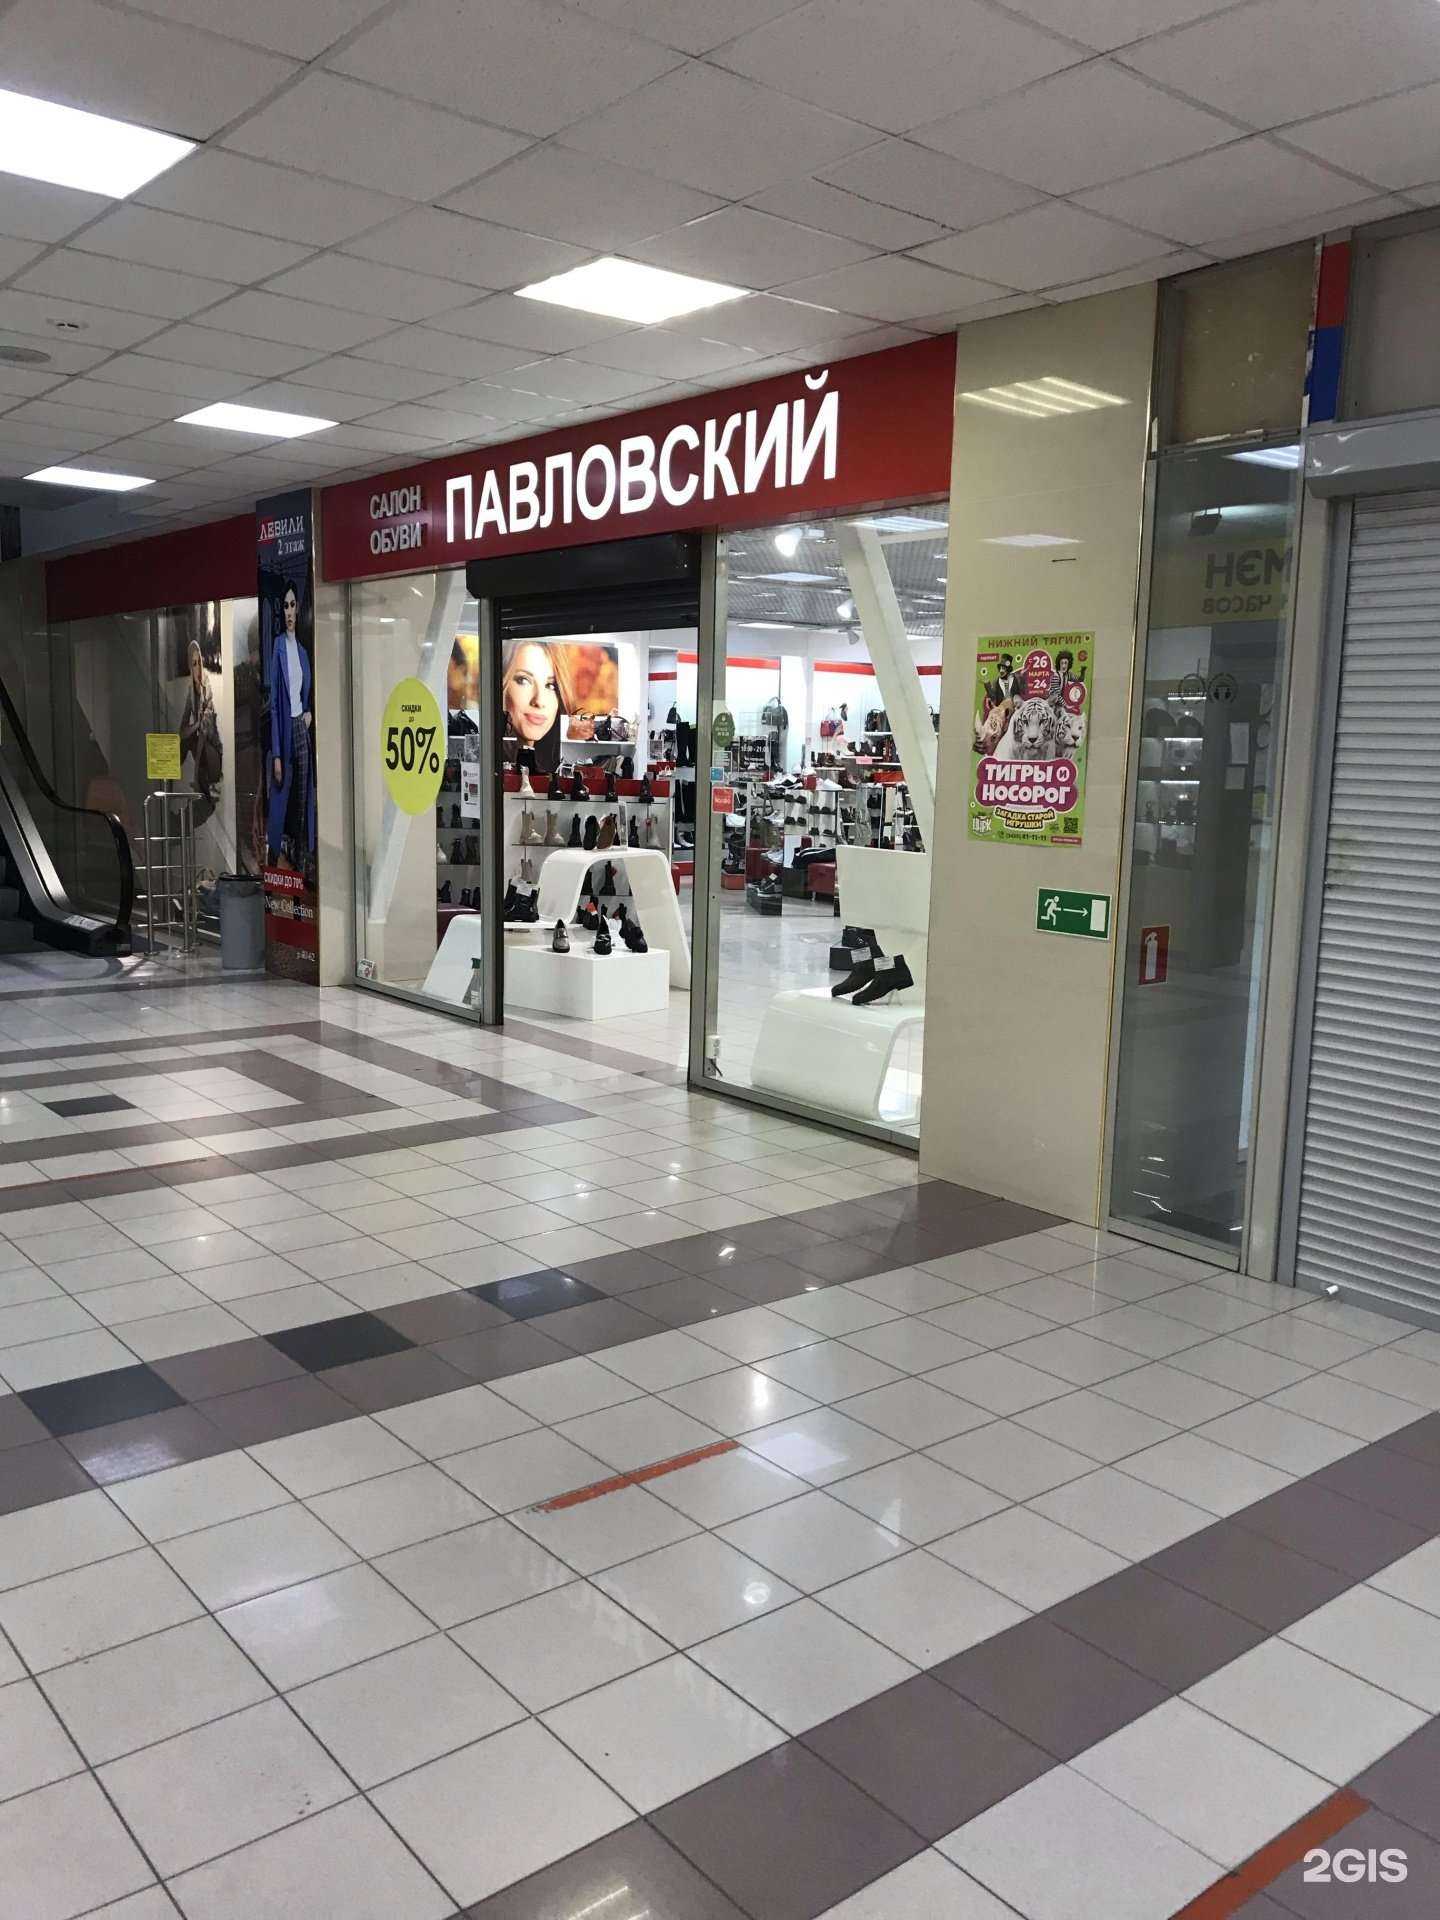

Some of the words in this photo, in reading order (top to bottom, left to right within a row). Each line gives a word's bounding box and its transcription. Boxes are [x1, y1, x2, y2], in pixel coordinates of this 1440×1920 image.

[446, 369, 839, 543] ПАВЛОВСКИЙ
[369, 484, 421, 520] САЛОН
[369, 521, 422, 555] ОБУВИ
[988, 636, 1038, 649] НИЖНИЙ
[1033, 655, 1048, 669] 26
[1033, 679, 1047, 690] 24
[385, 726, 440, 774] 50%
[985, 763, 1054, 783] ТИГРЫ
[982, 783, 1071, 805] НОСОРОГ
[1027, 809, 1054, 821] СТАРОЙ
